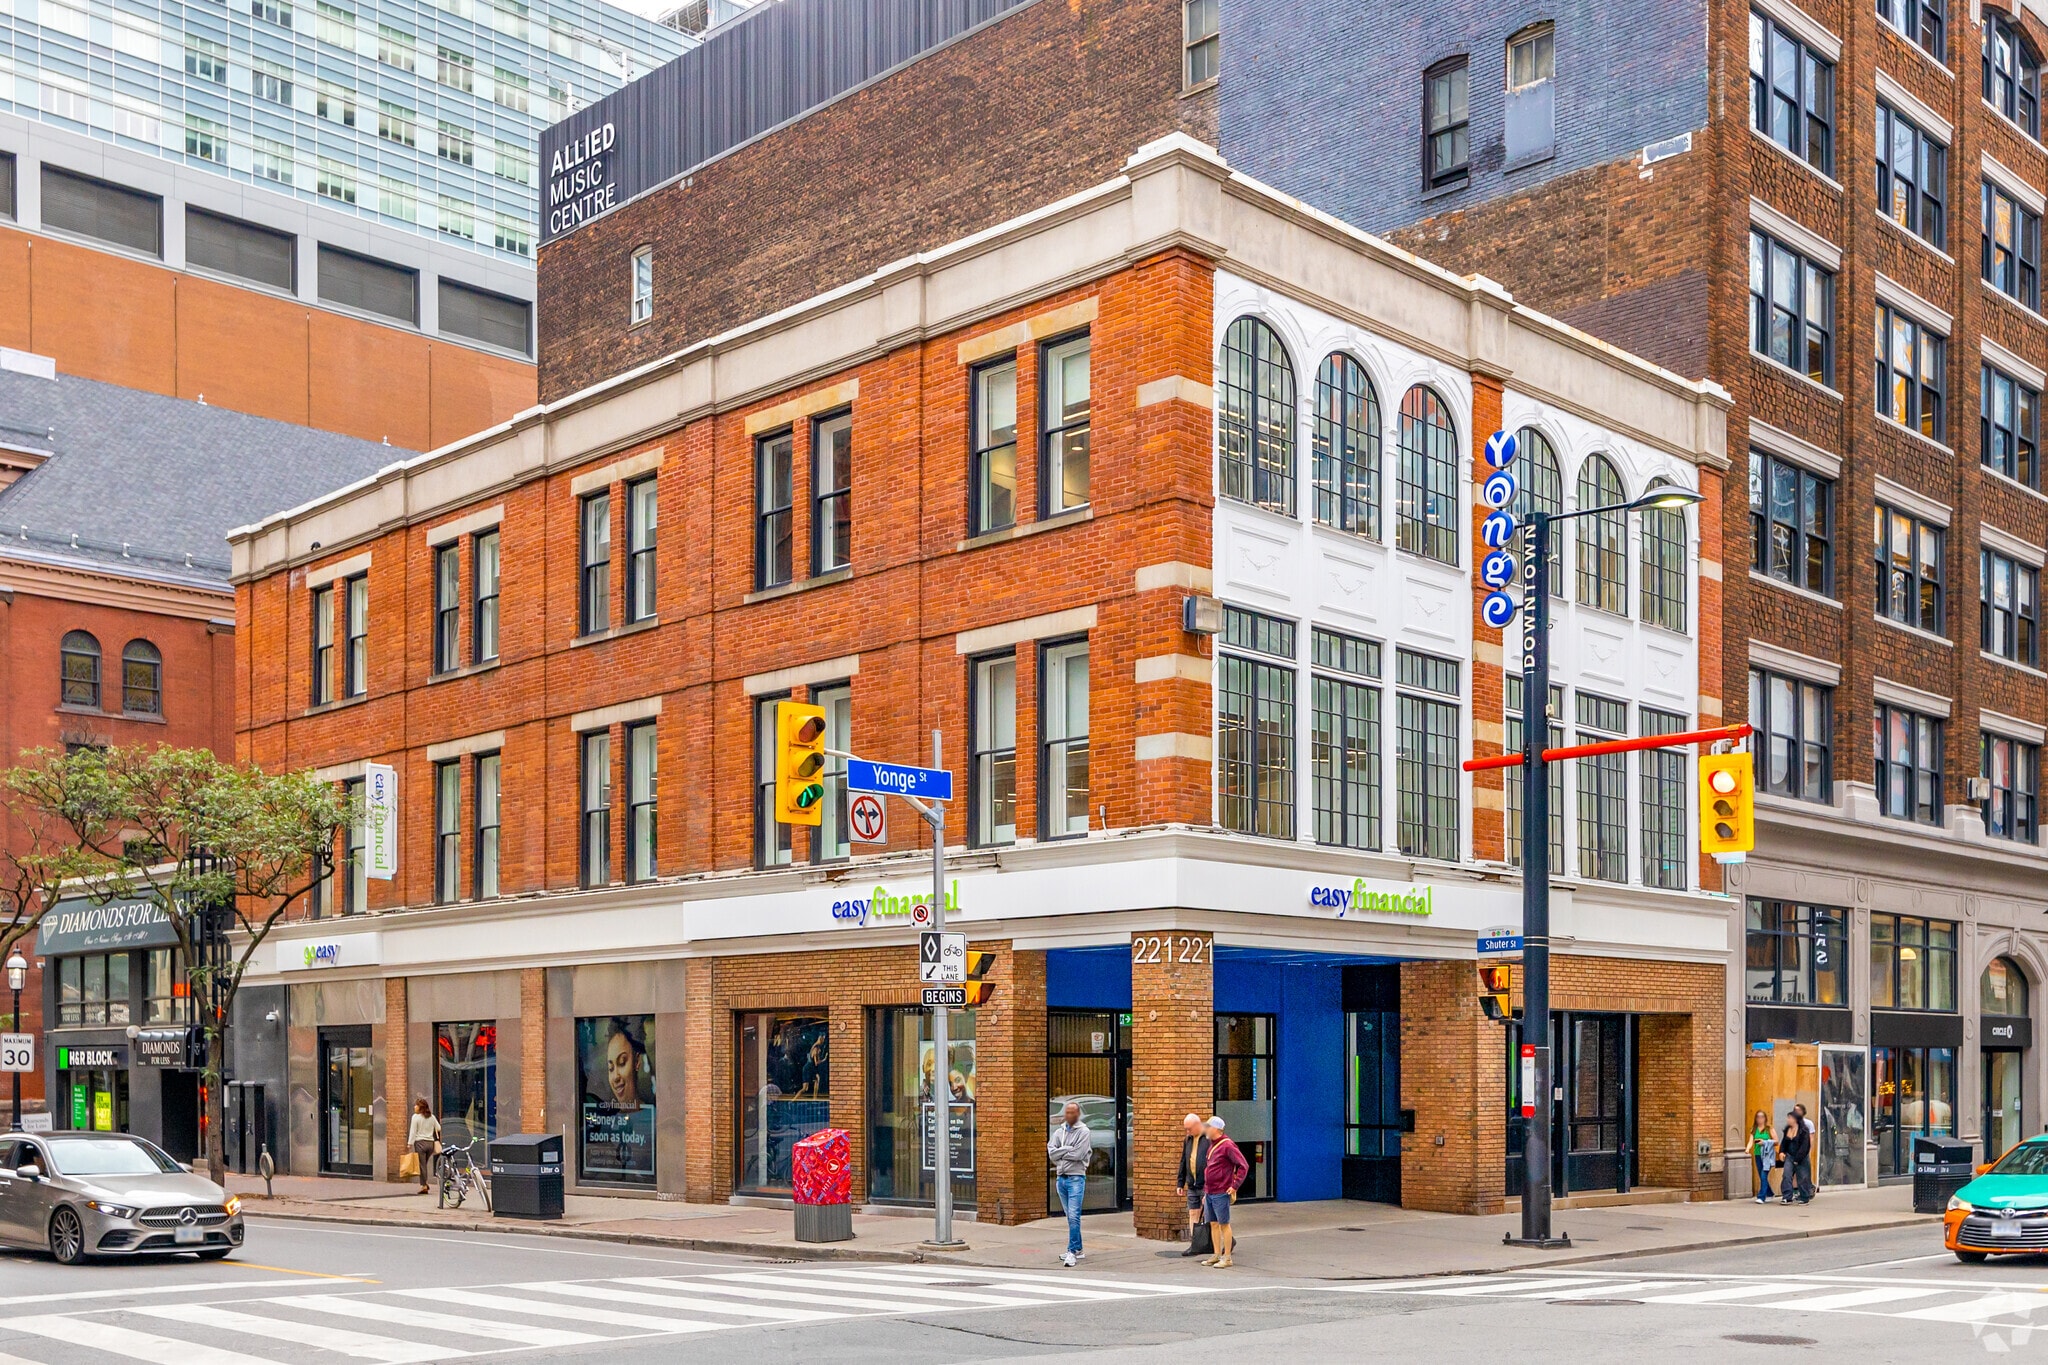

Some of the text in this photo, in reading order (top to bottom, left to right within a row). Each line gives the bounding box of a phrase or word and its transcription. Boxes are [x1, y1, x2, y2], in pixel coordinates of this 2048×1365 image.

[551, 122, 616, 178] ALLIED
[550, 160, 602, 207] MUSIC
[550, 182, 616, 234] CENTRE
[1523, 524, 1537, 668] DOWNTOWN
[872, 765, 927, 793] Yonge St
[1311, 878, 1432, 917] easyfinancial
[58, 906, 126, 935] DIAMONDS
[125, 903, 152, 927] FOR
[304, 943, 338, 965] goeasy
[1133, 936, 1213, 964] 221 221
[1485, 939, 1517, 950] Shuter St
[942, 964, 958, 972] THIS
[926, 990, 962, 1003] BEGINS
[4, 1049, 30, 1066] 30
[142, 1041, 180, 1055] DIAMONDS
[69, 1050, 113, 1066] H&R BLOCK
[150, 1056, 160, 1065] FOR
[160, 1056, 170, 1065] LESS
[589, 1131, 647, 1146] soon as today.
[540, 1166, 554, 1174] Litter
